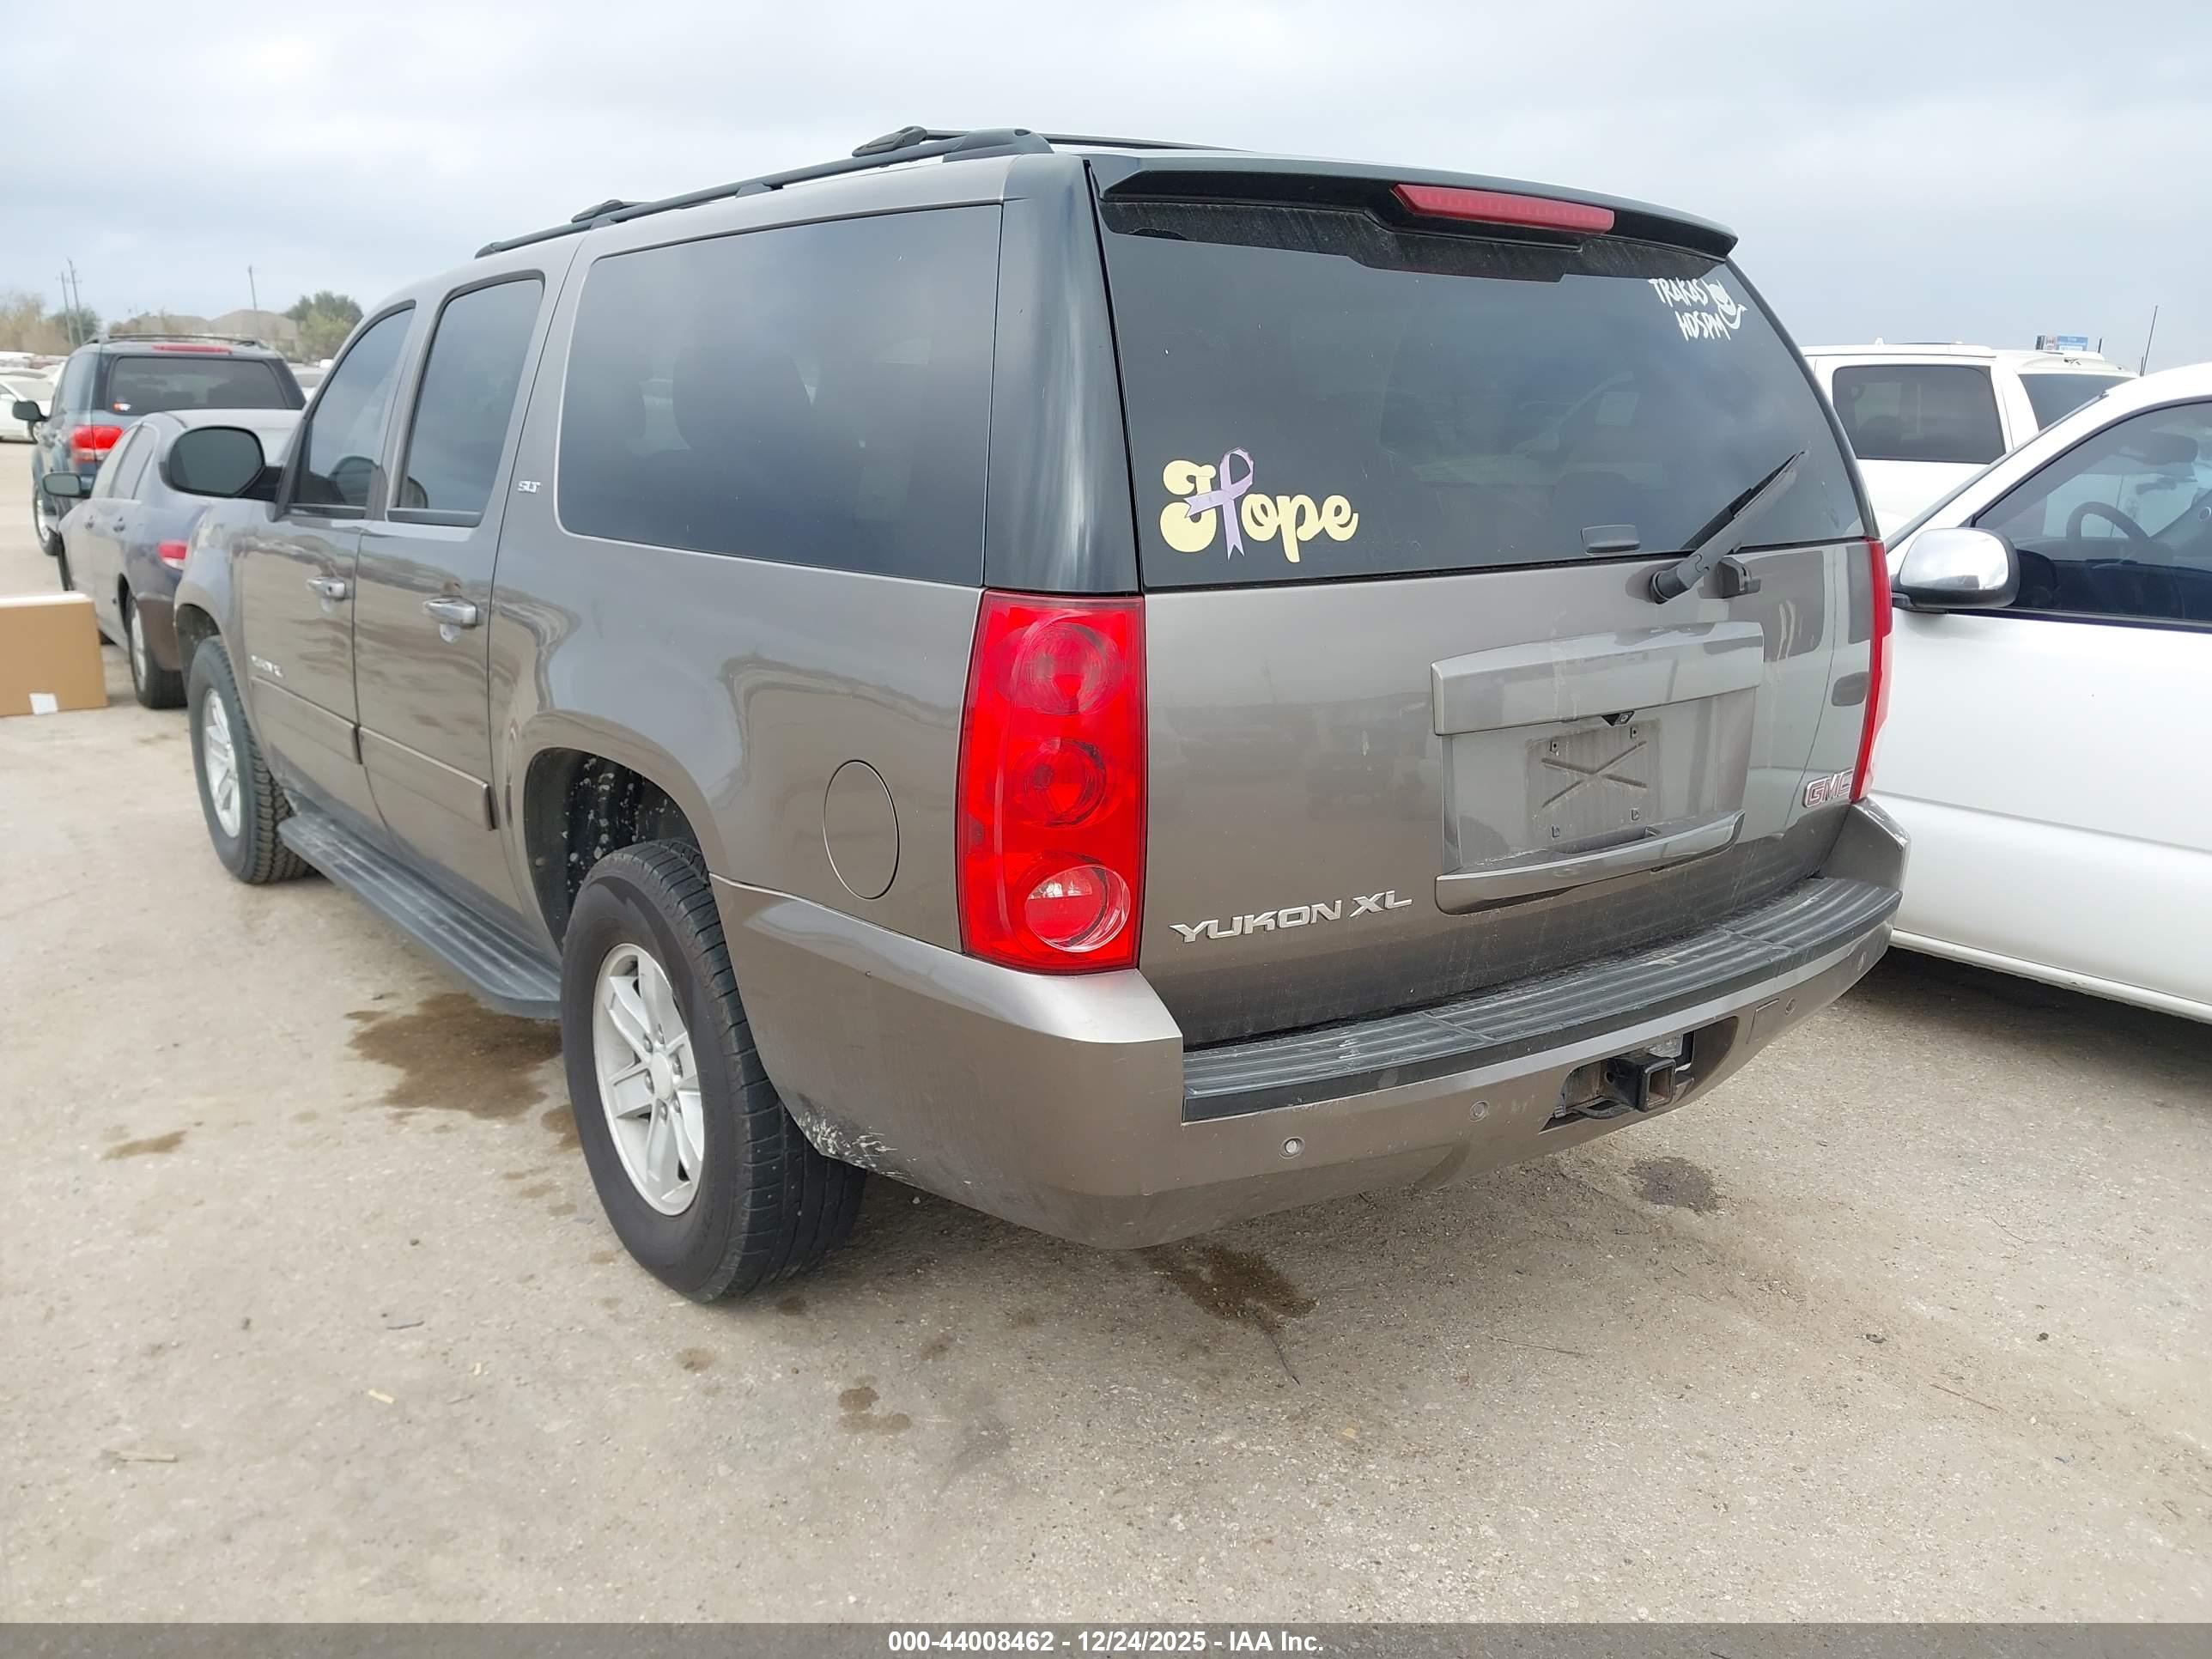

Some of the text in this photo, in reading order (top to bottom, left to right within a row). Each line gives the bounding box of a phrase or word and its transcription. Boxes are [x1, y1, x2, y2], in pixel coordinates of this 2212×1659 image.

[1648, 276, 1709, 307] TRAKAS
[518, 480, 542, 493] SLT
[1169, 890, 1413, 943] YUKON XL
